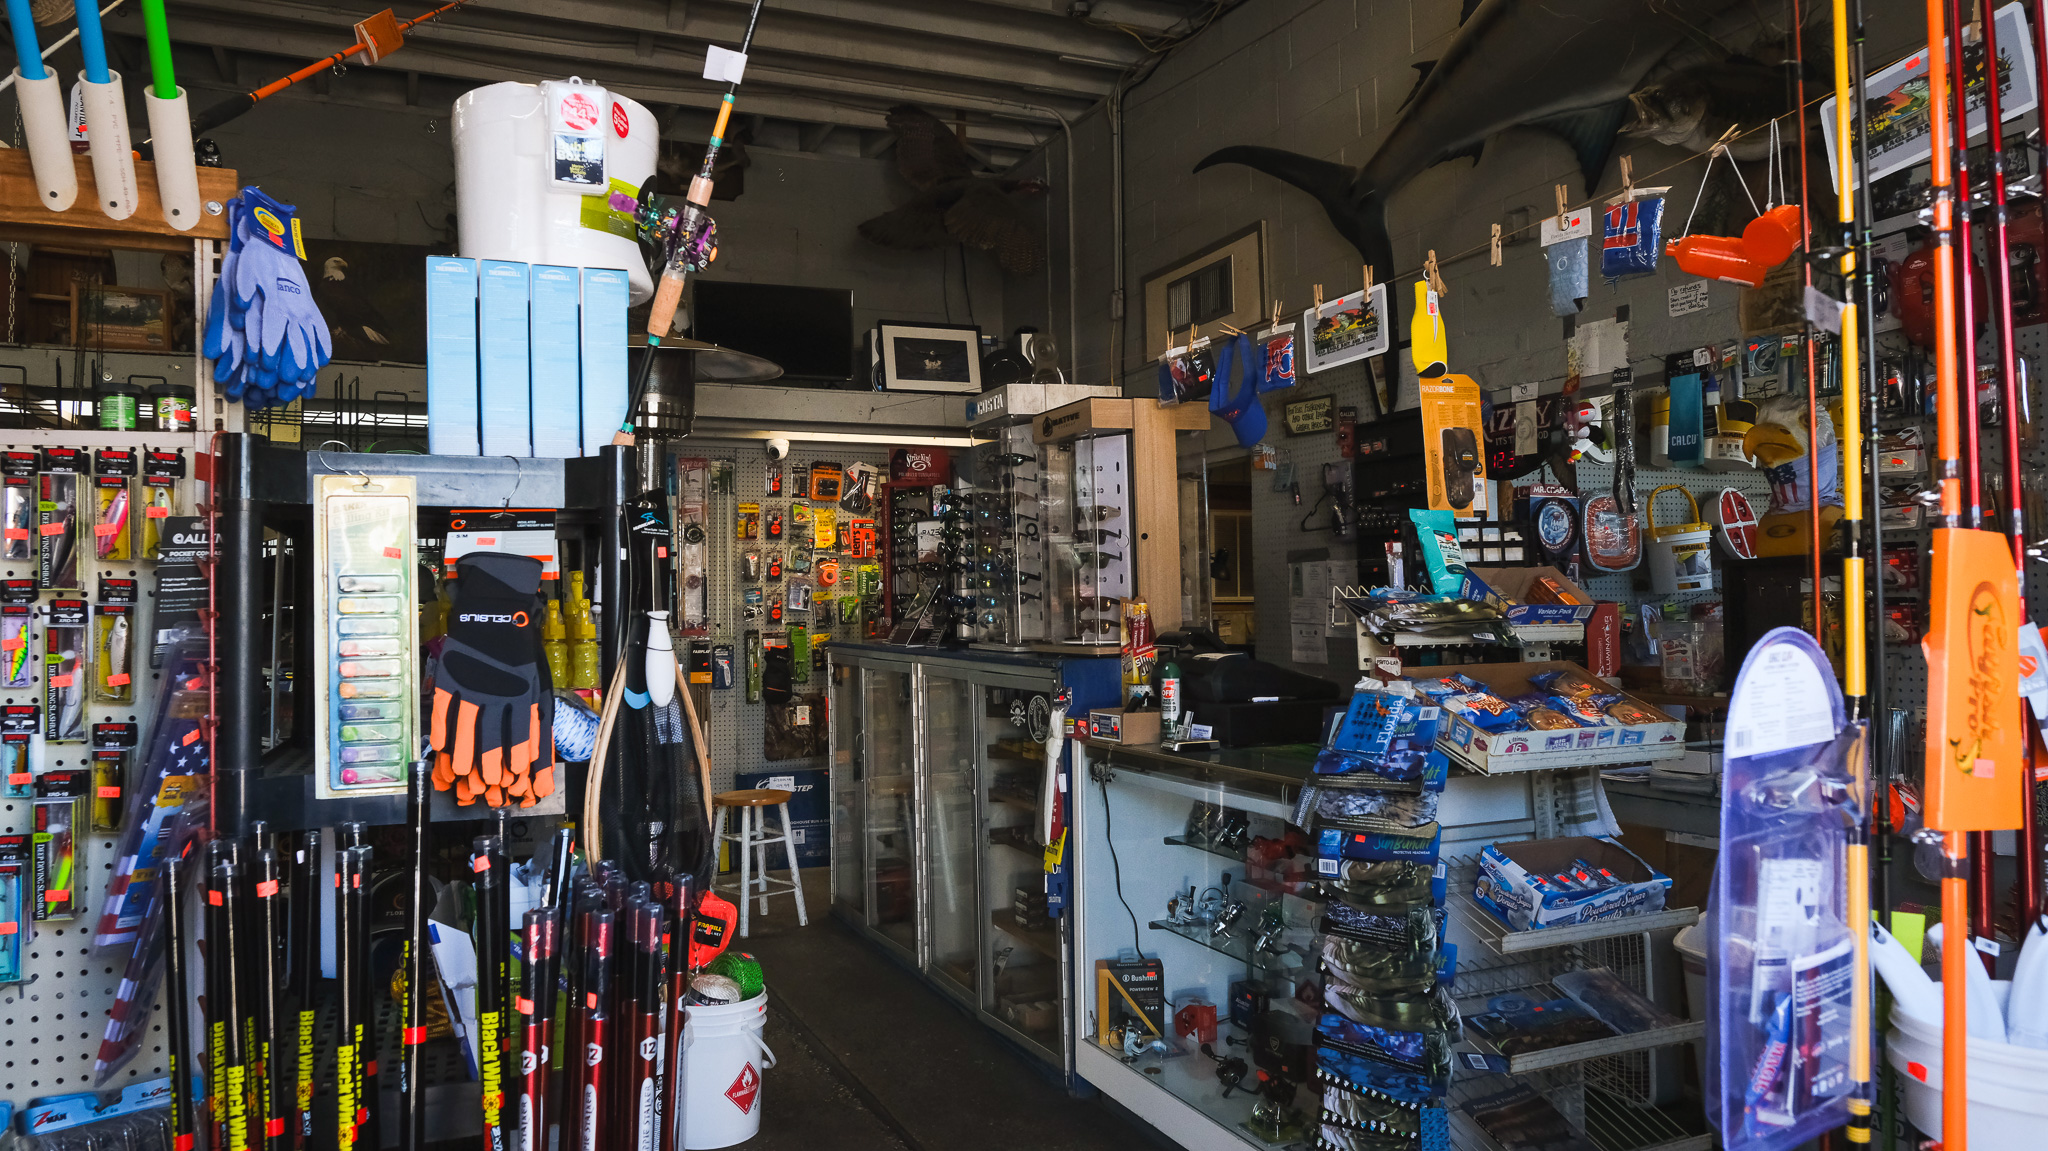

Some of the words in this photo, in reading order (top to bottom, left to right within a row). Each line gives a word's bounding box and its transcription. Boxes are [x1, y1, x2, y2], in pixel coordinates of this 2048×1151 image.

[1882, 131, 1912, 147] EAGLE
[977, 394, 1004, 416] COSTA
[1053, 412, 1080, 425] NATIVE
[1671, 434, 1699, 447] CALCU
[183, 533, 223, 544] ALLN
[459, 614, 512, 623] CELSIUS
[1377, 699, 1403, 745] Florida
[1511, 744, 1522, 753] 16
[1477, 890, 1484, 898] 12
[1496, 895, 1518, 910] Donuts
[1516, 896, 1532, 909] Sugar
[1581, 899, 1620, 922] Powdered
[1621, 892, 1648, 907] Sugar
[643, 1042, 657, 1055] 12
[723, 1086, 743, 1098] FLAMMABLE
[644, 1083, 653, 1125] STALKER
[584, 1091, 593, 1132] STALKER
[520, 1100, 529, 1144] STALKER
